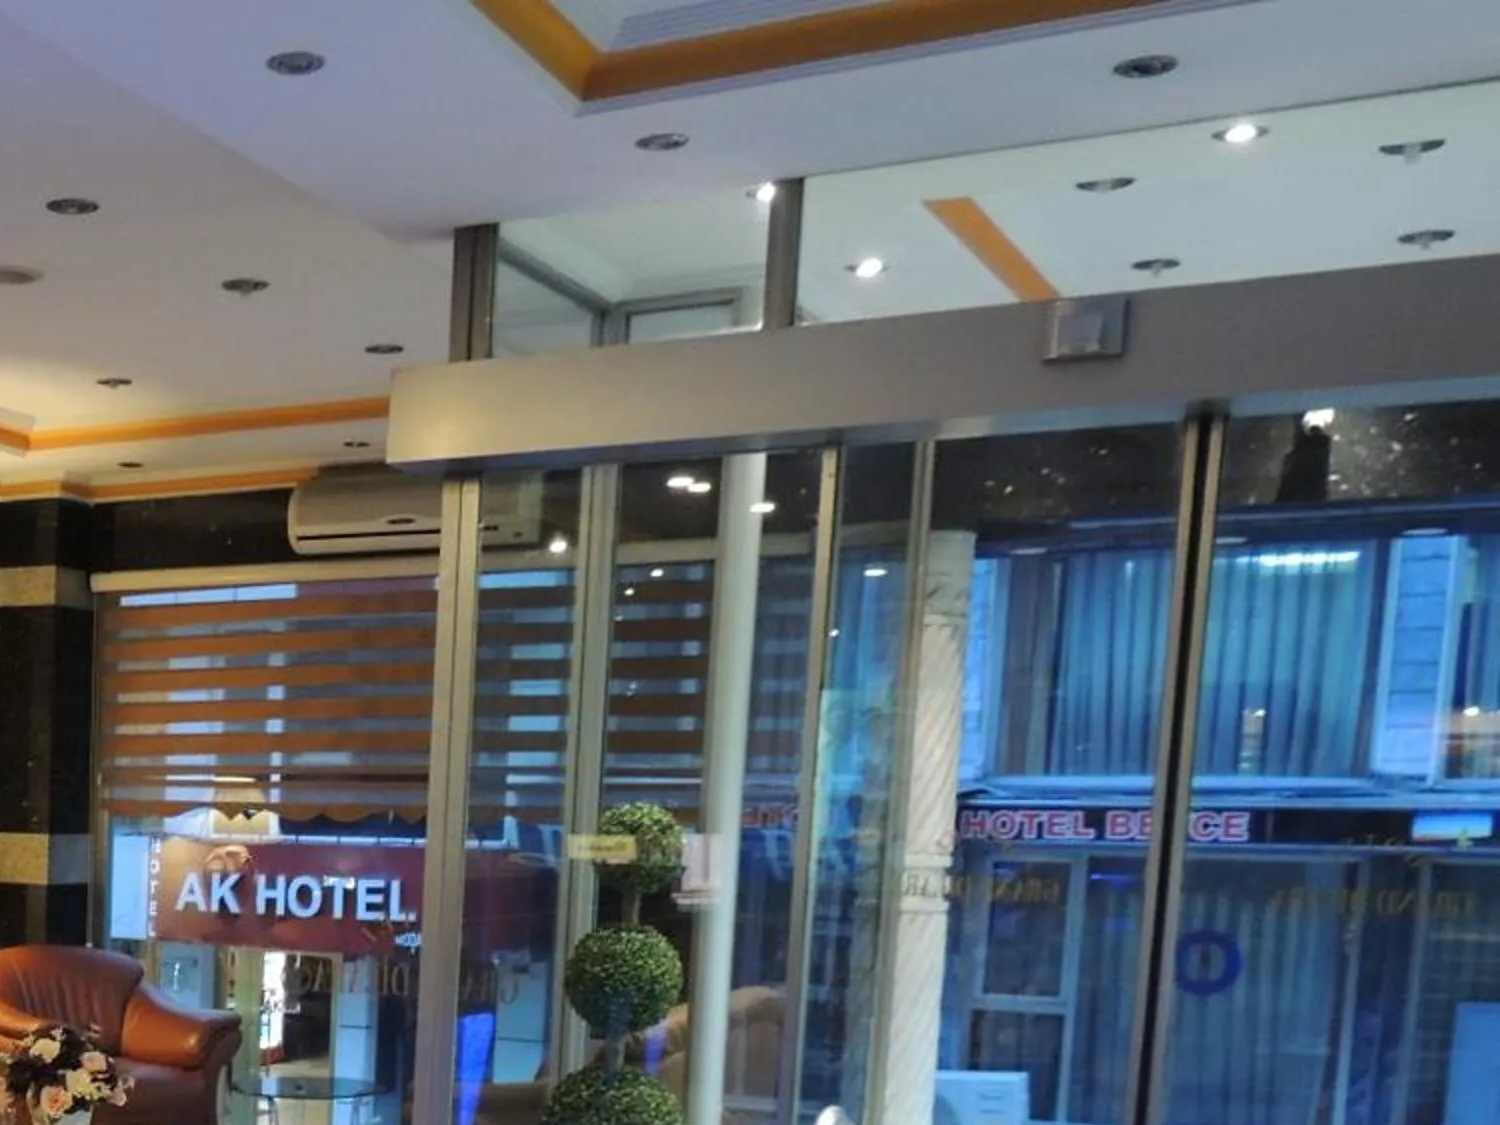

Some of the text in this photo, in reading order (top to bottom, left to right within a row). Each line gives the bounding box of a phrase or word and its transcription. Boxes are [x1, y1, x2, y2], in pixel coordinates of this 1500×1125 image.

[960, 811, 1251, 841] HOTEL BECE
[148, 837, 162, 937] HOTEL
[174, 872, 417, 922] AK HOTEL
